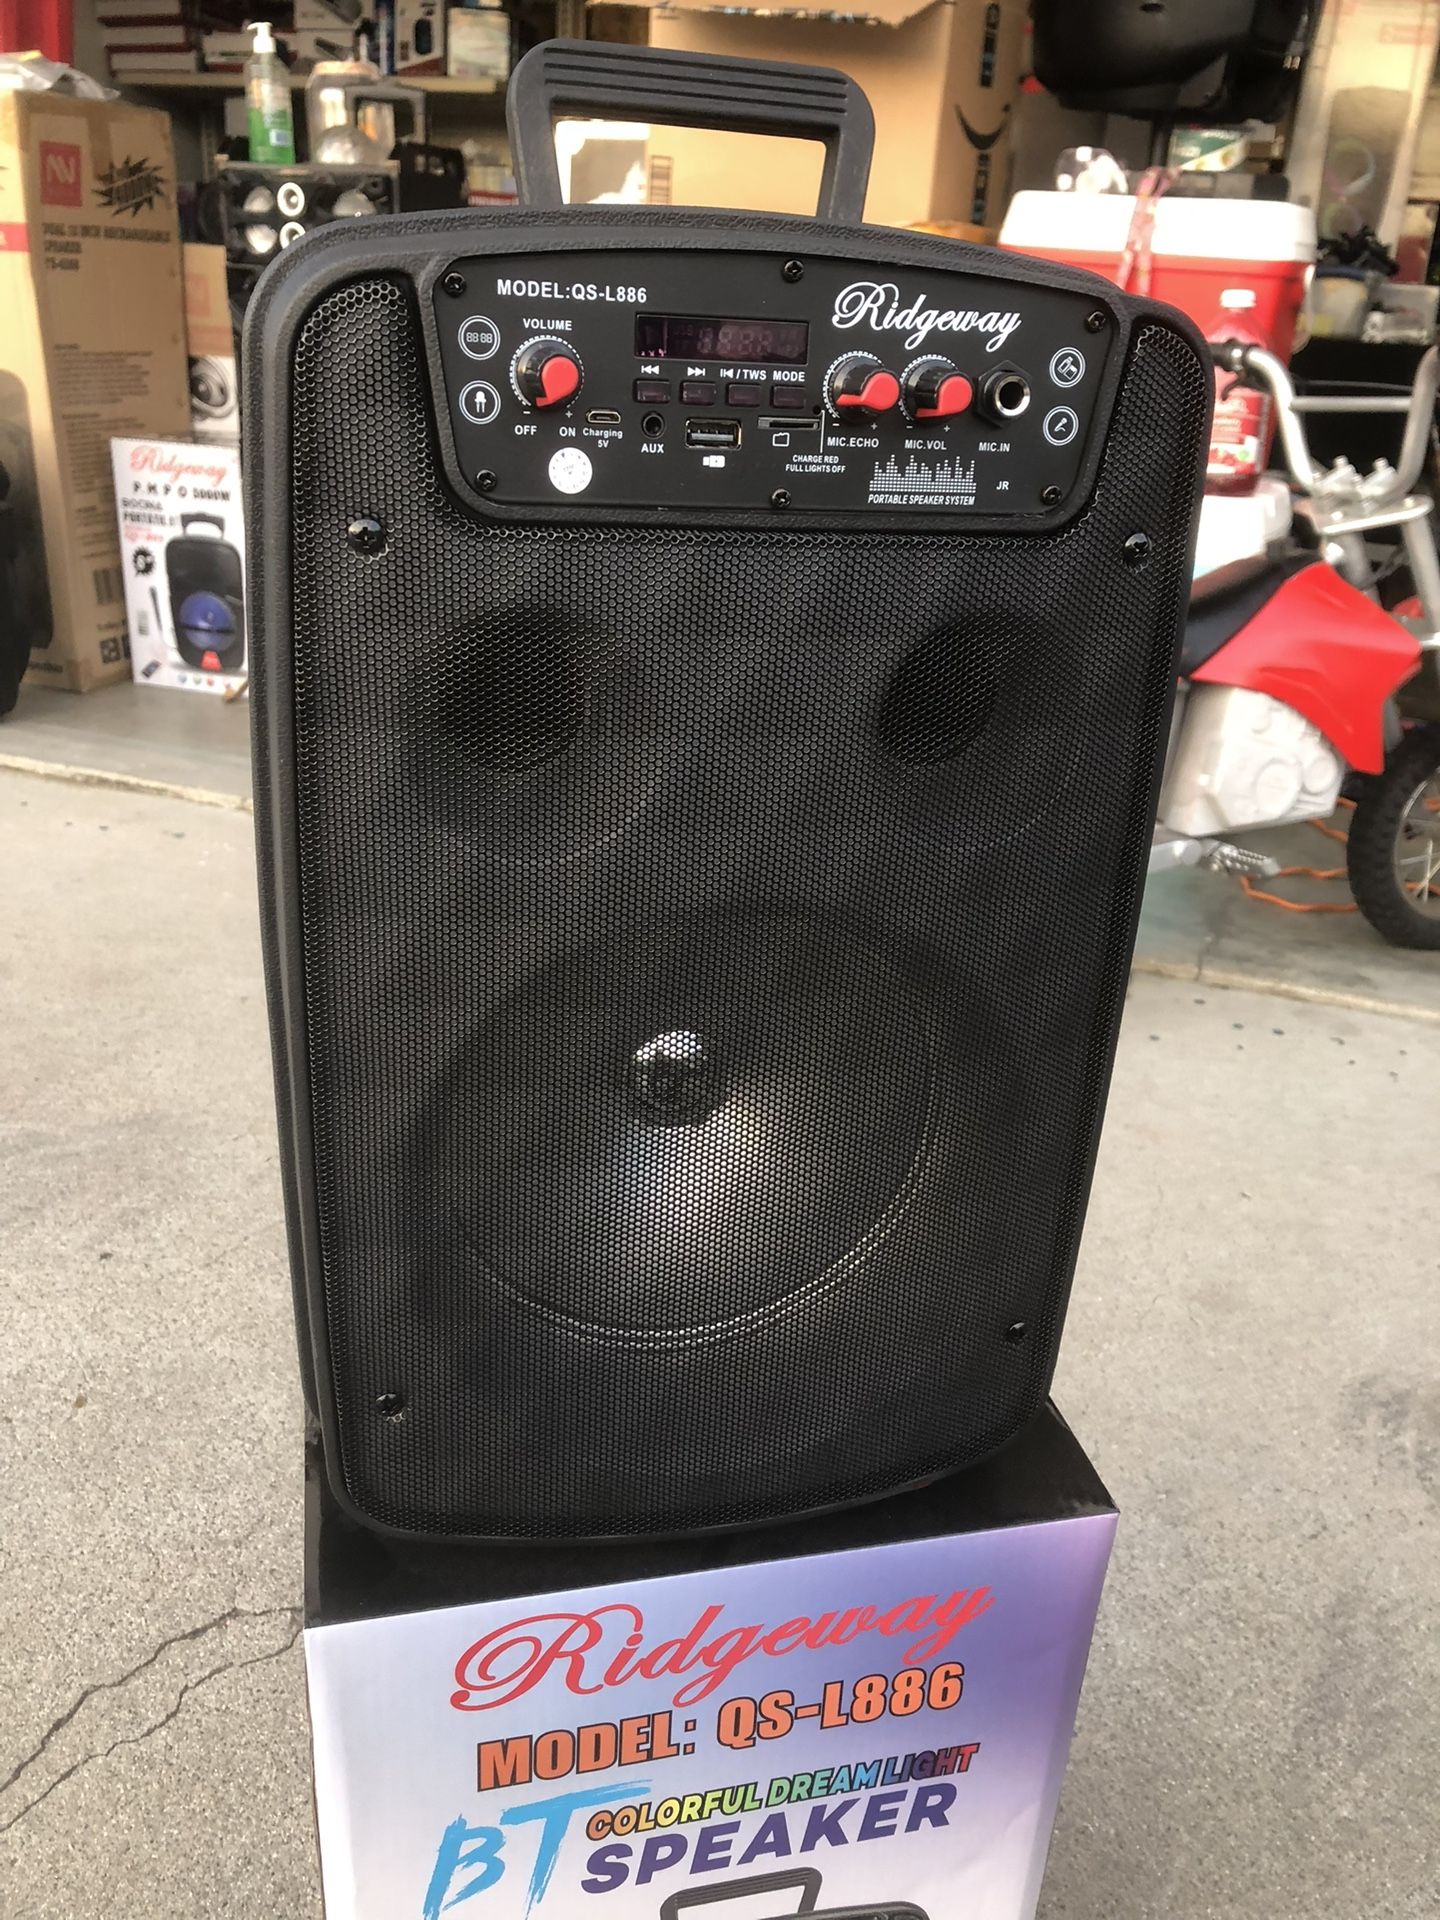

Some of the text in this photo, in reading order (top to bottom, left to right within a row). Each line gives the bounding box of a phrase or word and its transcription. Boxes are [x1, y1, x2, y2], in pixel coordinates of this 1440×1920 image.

[832, 281, 1022, 353] Ridgeway
[523, 318, 572, 331] VOLUME
[773, 371, 805, 382] MODE
[514, 425, 537, 436] OFF
[559, 427, 576, 437] ON
[582, 427, 623, 439] Charging
[598, 440, 609, 448] 5V
[641, 443, 664, 453] AUX
[827, 437, 879, 448] MIC.ECHO
[905, 440, 947, 450] MIC.VOL
[978, 442, 1010, 452] MIC.IN
[792, 455, 823, 464] CHARGE
[785, 464, 804, 473] FULL
[805, 465, 831, 473] LIGHTS
[996, 481, 1010, 490] JR
[868, 494, 975, 505] PORTABLE SPEAKER SYSTEM
[450, 1585, 995, 1712] Ridgeway
[477, 1662, 965, 1792] MODEL: QS-L886
[586, 1743, 981, 1841] COLORFUL DREAM LIGHT
[580, 1783, 958, 1894] SPEAKER
[422, 1778, 653, 1920] BT
